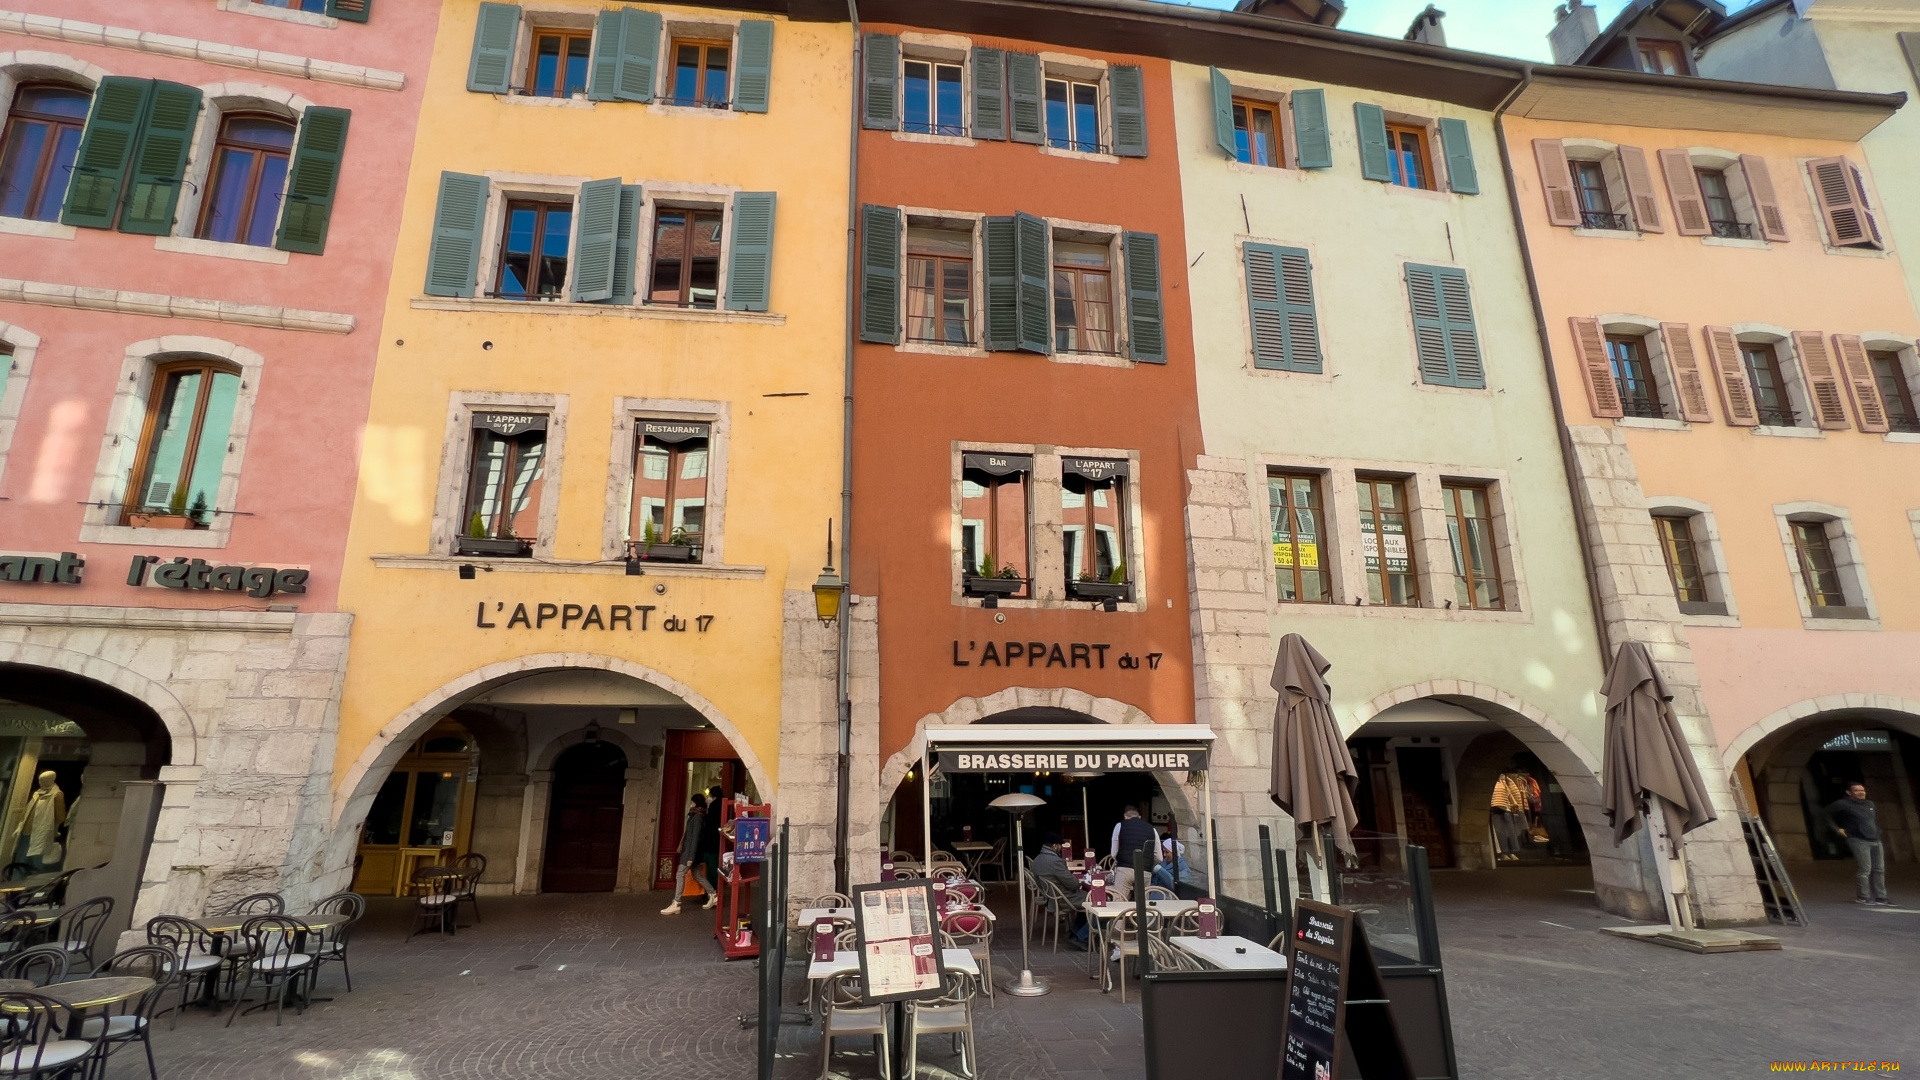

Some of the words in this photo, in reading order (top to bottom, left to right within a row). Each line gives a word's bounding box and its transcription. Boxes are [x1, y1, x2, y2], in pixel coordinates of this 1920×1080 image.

[486, 415, 533, 424] L'APPART
[501, 423, 515, 433] 17
[645, 423, 700, 434] RESTAURANT
[989, 457, 1007, 467] BAR
[1075, 460, 1116, 470] L'APPART
[1090, 468, 1102, 478] 17
[126, 554, 310, 598] l'étage
[476, 601, 656, 631] L'APPART
[663, 614, 686, 632] du
[695, 614, 714, 632] 17
[953, 640, 1111, 669] L'APPART
[1118, 652, 1139, 670] du
[1146, 652, 1163, 670] 17
[958, 754, 1069, 769] BRASSERIE
[1074, 754, 1101, 769] DU
[1107, 753, 1190, 769] PAQUIER
